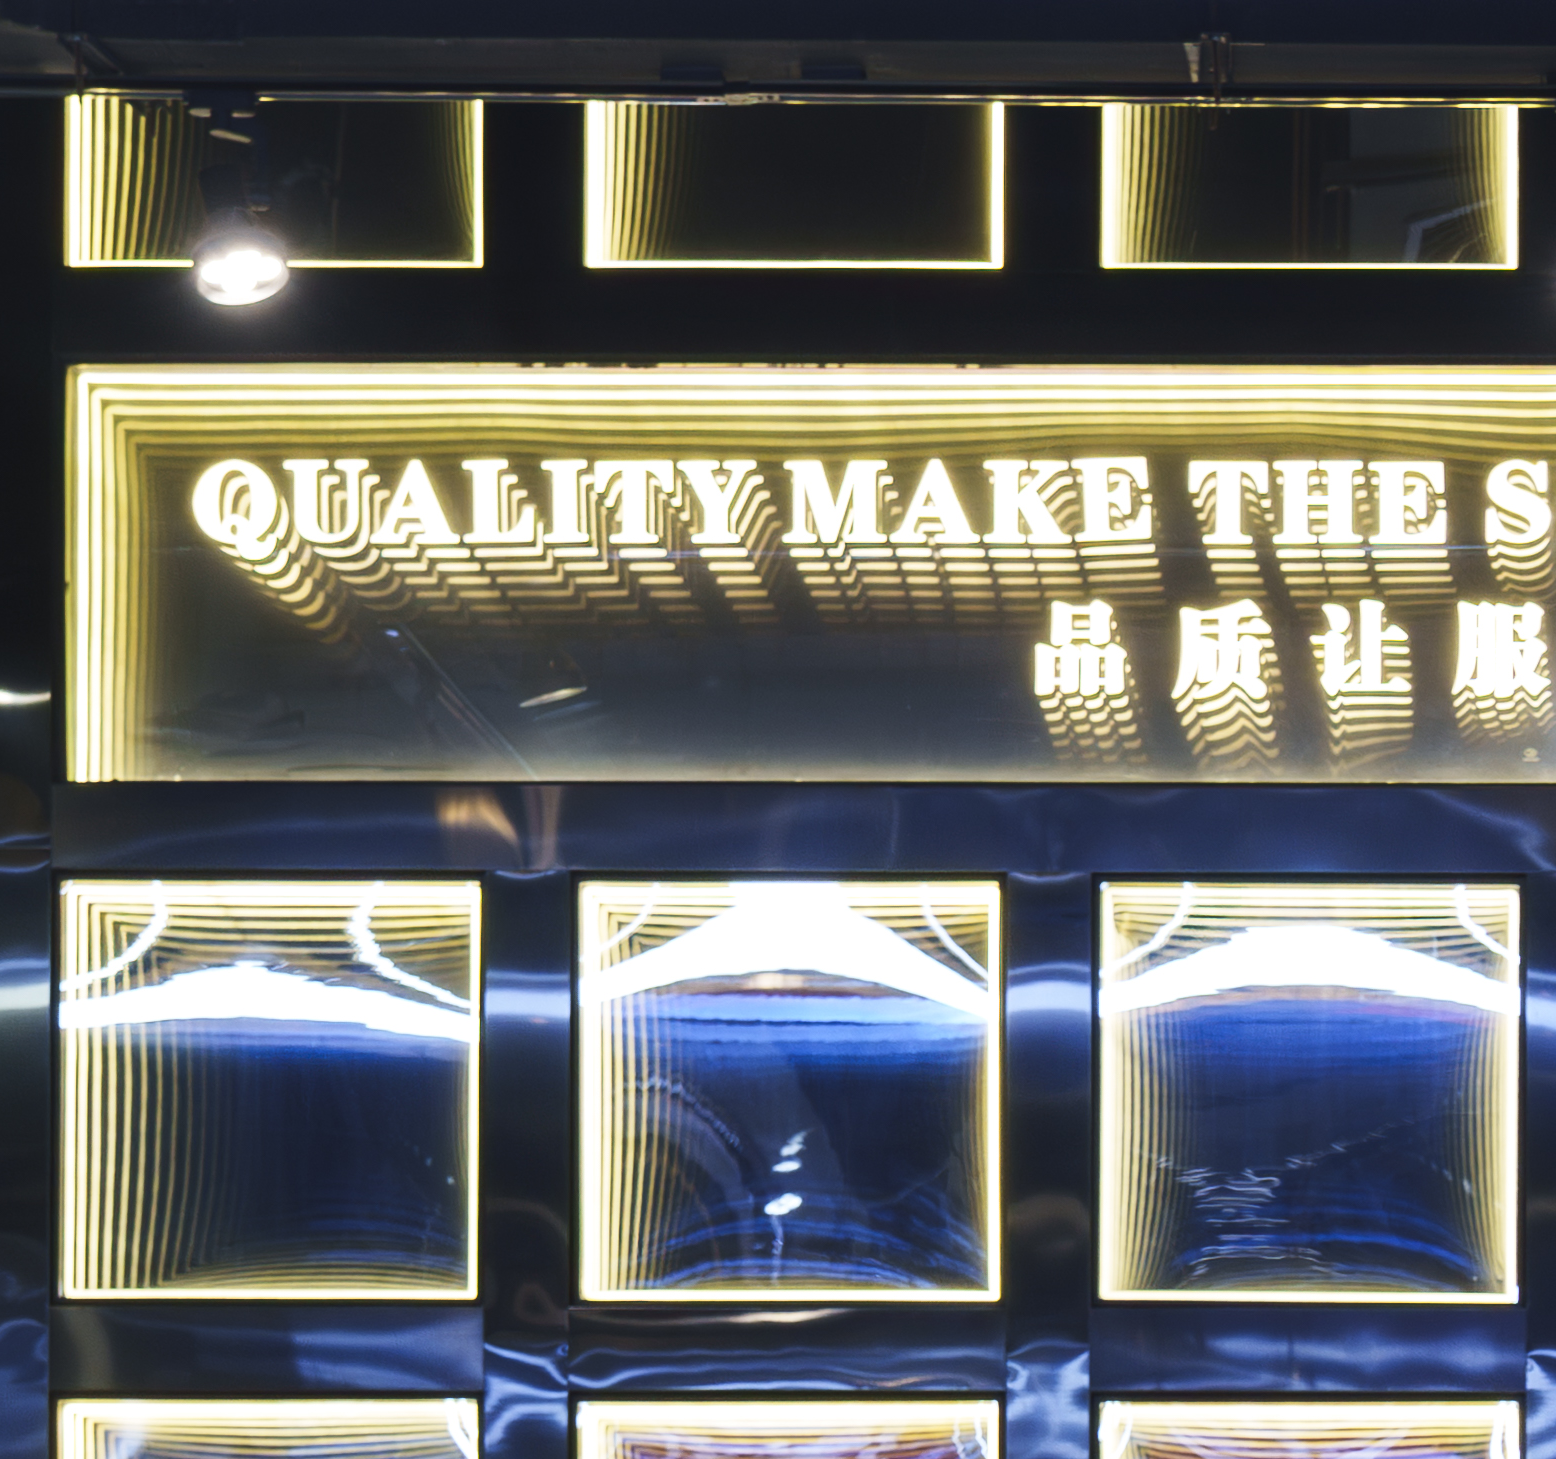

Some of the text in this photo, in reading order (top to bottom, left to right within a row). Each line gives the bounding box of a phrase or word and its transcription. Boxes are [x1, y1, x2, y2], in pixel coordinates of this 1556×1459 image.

[190, 456, 764, 562] QUALITY
[780, 456, 1155, 546] MAKE
[1186, 458, 1448, 546] THE
